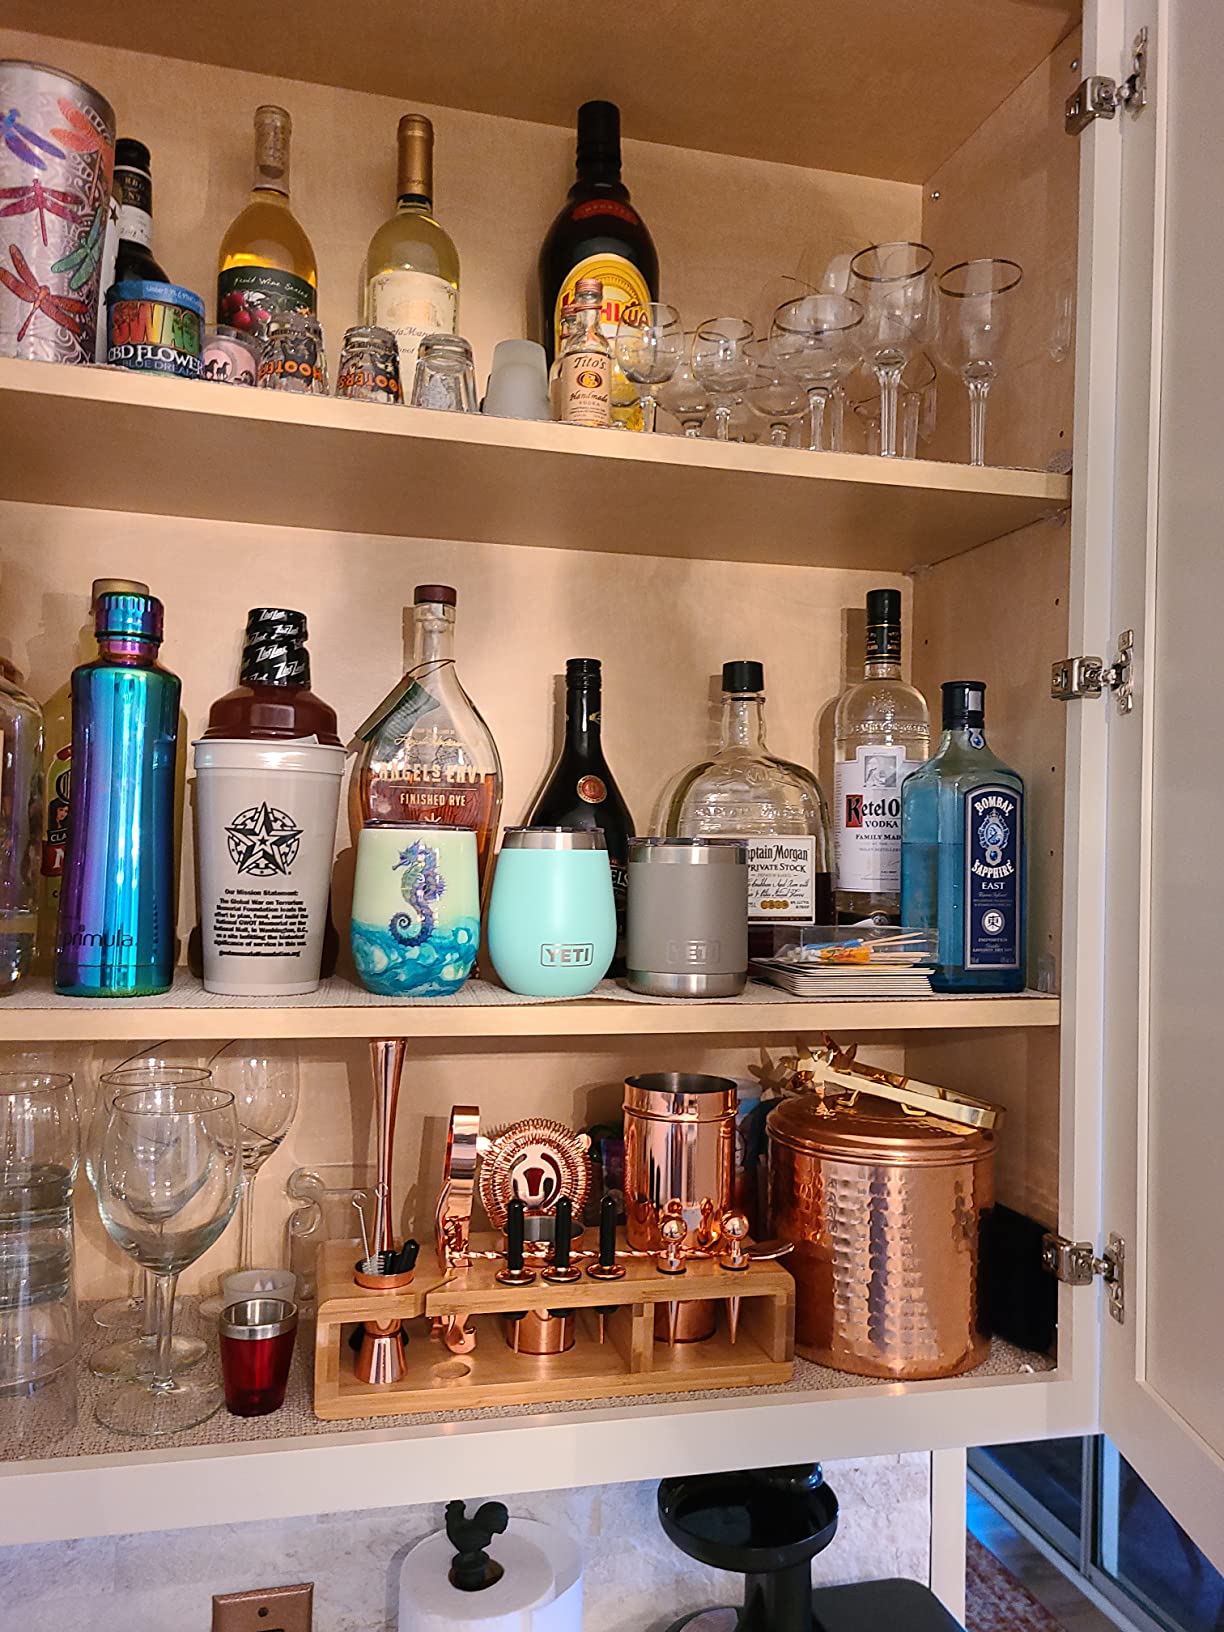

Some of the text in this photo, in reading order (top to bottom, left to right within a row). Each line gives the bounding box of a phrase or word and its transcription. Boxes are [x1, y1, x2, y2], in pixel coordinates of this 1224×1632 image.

[108, 345, 205, 376] CBD FLOWER
[573, 356, 607, 371] Tito's
[446, 765, 487, 784] ENVY
[400, 793, 466, 806] FINISHED RYE
[974, 796, 1014, 816] BOMBAY
[846, 796, 885, 825] Ketel
[865, 820, 899, 828] VODKA
[49, 832, 67, 843] CLA
[748, 845, 808, 862] ptain Morgan
[748, 863, 807, 873] PRIVATE STOCK
[971, 859, 1015, 878] SAPPHIRE
[981, 882, 1005, 890] EAST
[64, 924, 134, 950] primula
[545, 947, 590, 963] YETI
